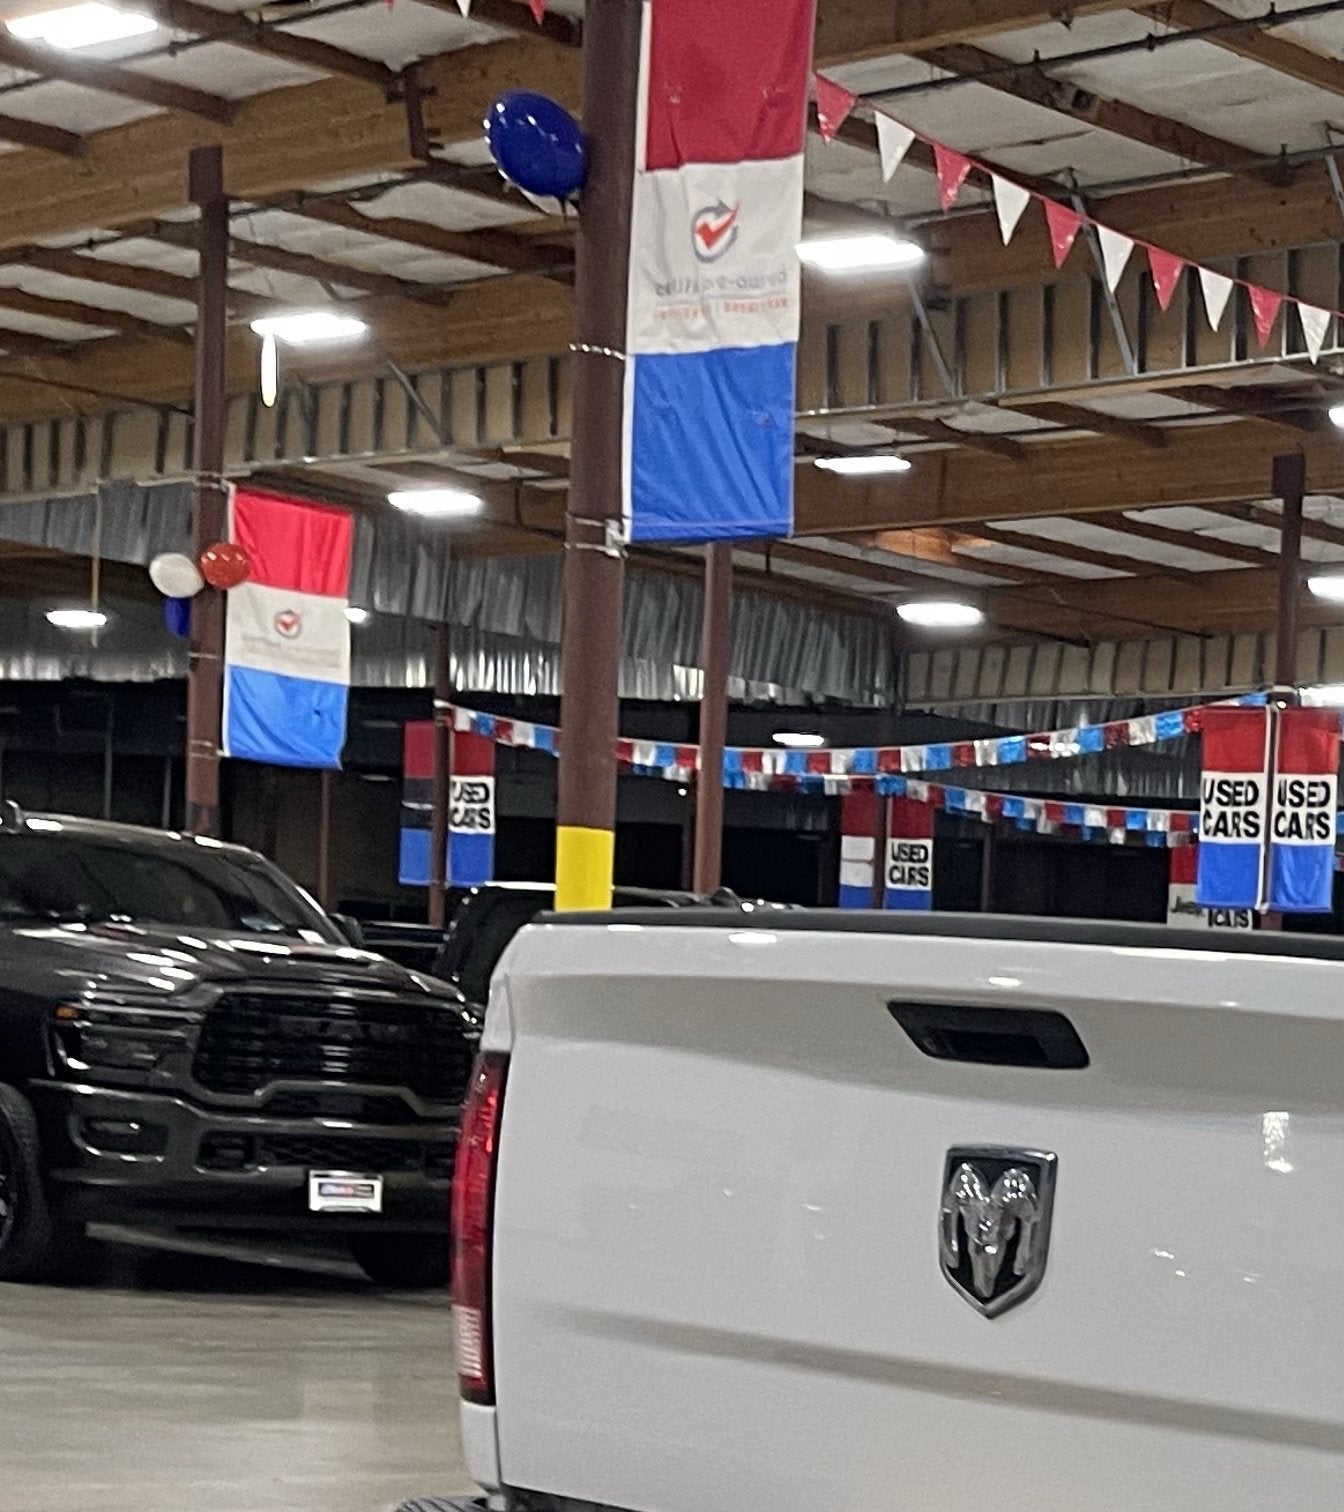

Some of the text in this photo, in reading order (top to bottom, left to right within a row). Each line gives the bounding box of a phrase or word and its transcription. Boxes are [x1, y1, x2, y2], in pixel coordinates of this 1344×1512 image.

[1203, 778, 1259, 807] USED
[1277, 779, 1331, 808] USED
[1203, 809, 1260, 838] CARS
[1274, 810, 1330, 840] CARS
[891, 842, 928, 863] USED
